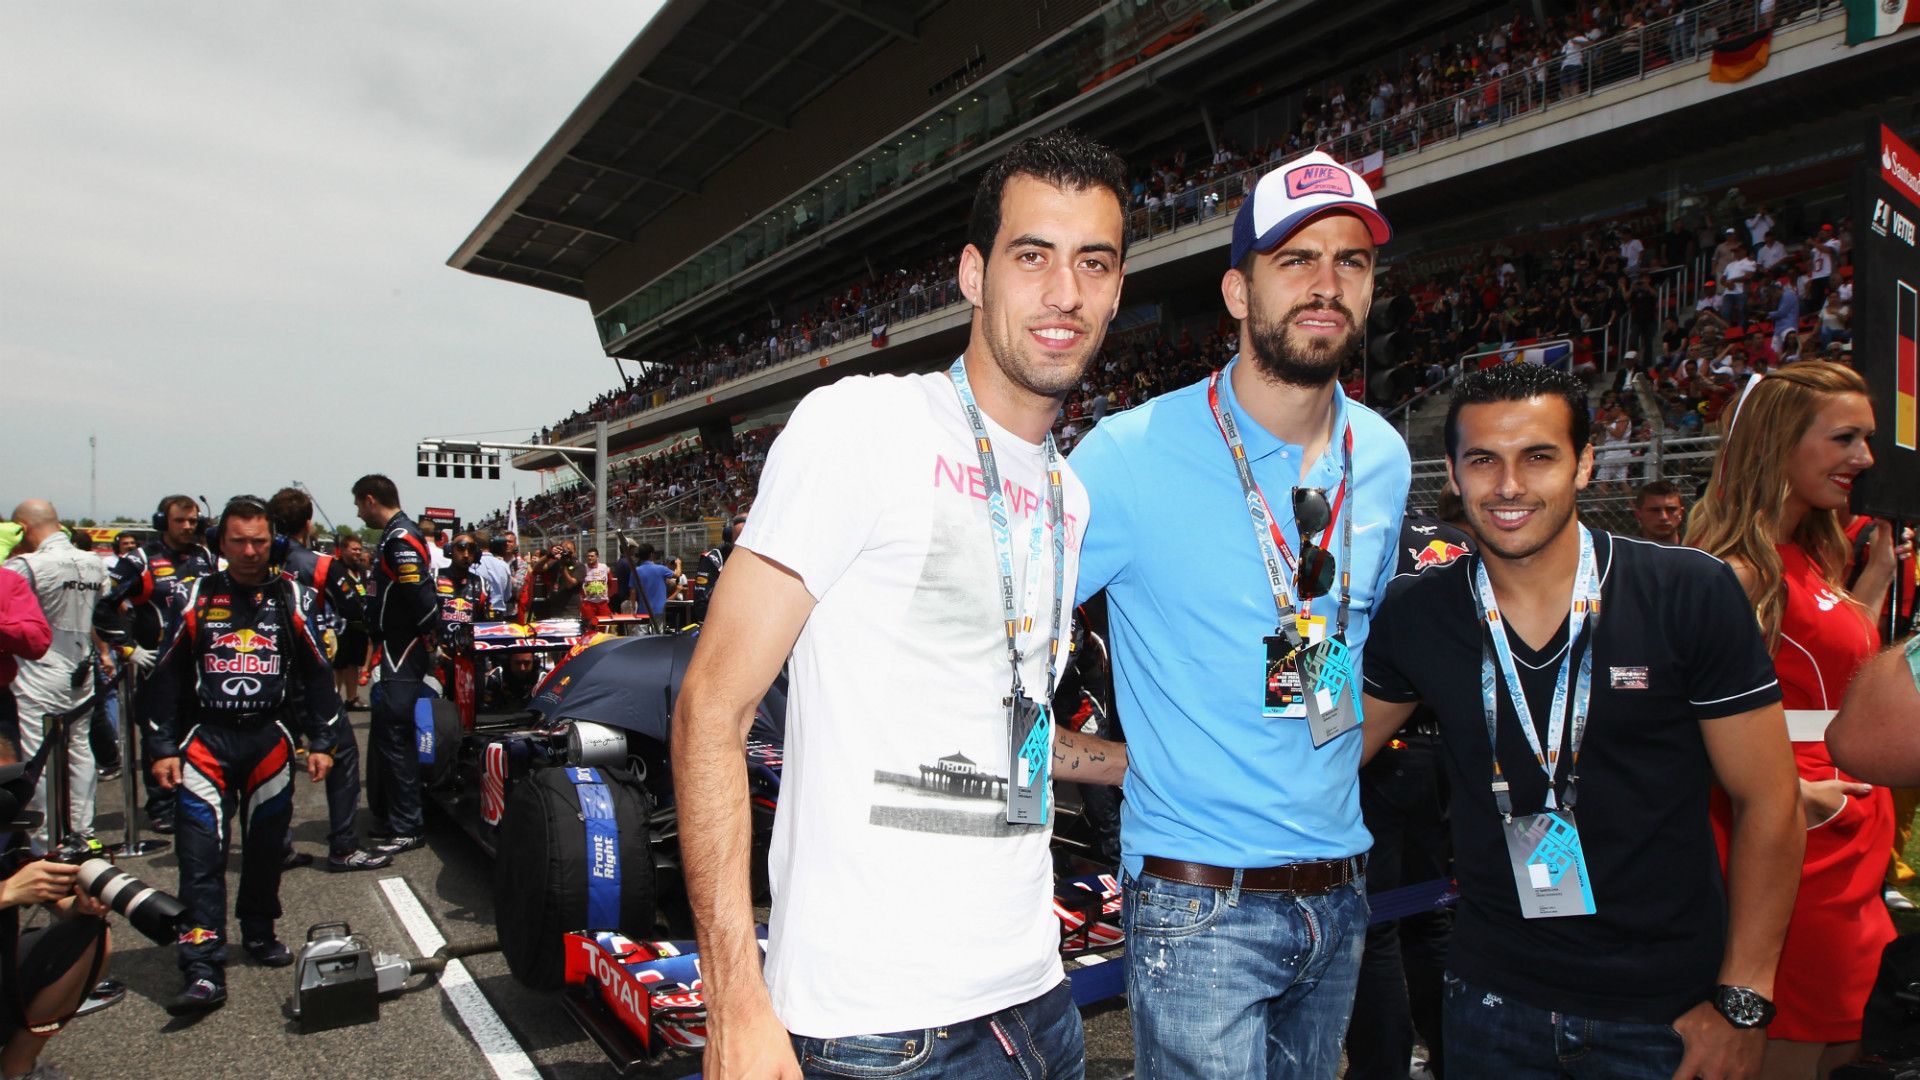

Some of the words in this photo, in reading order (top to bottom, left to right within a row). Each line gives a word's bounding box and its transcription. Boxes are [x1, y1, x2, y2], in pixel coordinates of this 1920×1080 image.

[1303, 167, 1334, 180] NIKE
[1892, 210, 1916, 247] VETTEL
[934, 454, 1077, 540] NEWPRT
[204, 652, 243, 673] Red
[245, 654, 281, 675] Bull
[209, 700, 272, 709] INFINITI
[593, 834, 604, 878] Front
[603, 836, 617, 879] Right
[582, 941, 648, 1025] TOTAL
